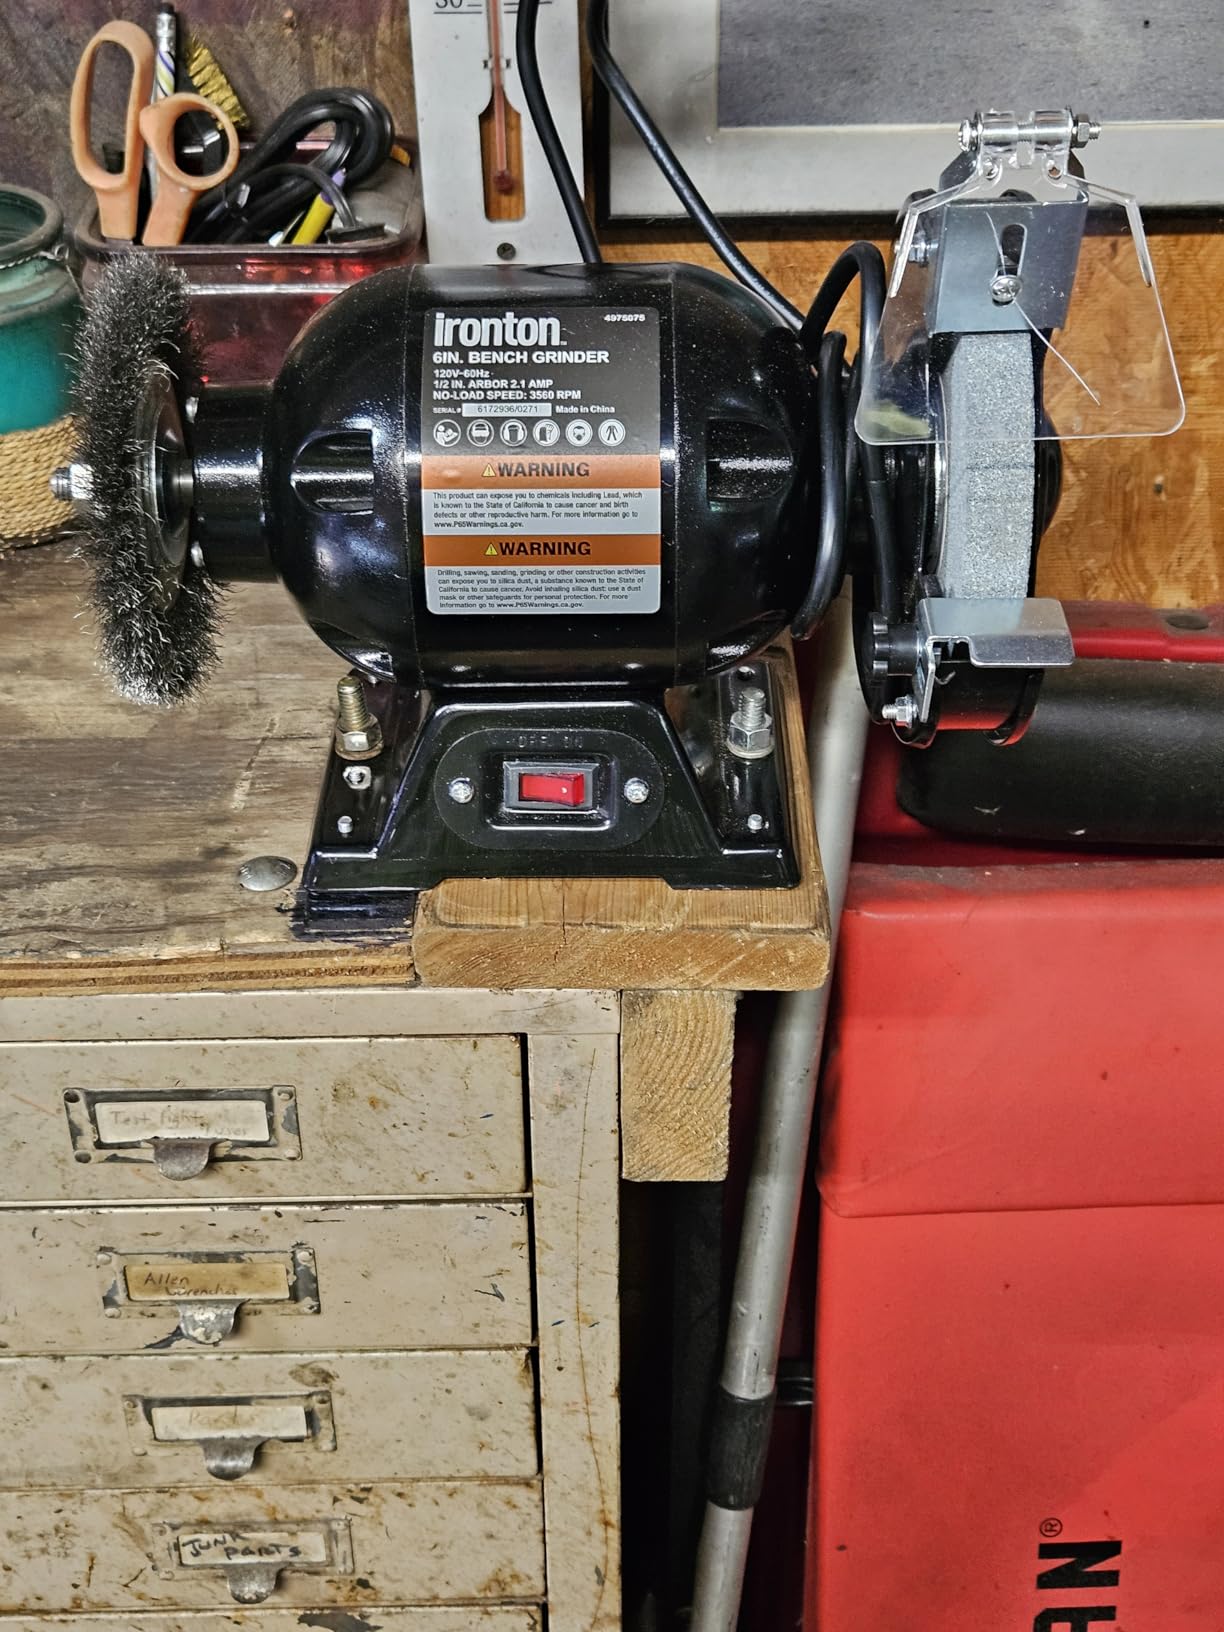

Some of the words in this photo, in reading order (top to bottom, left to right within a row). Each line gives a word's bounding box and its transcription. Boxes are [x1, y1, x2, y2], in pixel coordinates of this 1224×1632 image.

[434, 312, 561, 347] ironton
[433, 351, 464, 364] 6IN.
[468, 351, 528, 364] BENCH
[532, 351, 610, 364] GRINDER
[433, 380, 449, 389] 1/2
[451, 380, 466, 389] IN.
[468, 379, 508, 389] ARBOR
[510, 379, 525, 388] 2.1
[528, 379, 553, 388] AMP
[433, 390, 484, 400] NO-LOAD
[486, 390, 527, 400] SPEED:
[529, 390, 554, 400] 3560
[556, 390, 581, 400] RPM
[477, 405, 538, 413] 6172936/0271
[556, 405, 579, 413] Made
[580, 405, 589, 413] in
[590, 405, 615, 413] China
[498, 462, 590, 477] WARNING
[448, 492, 475, 501] product
[515, 493, 527, 501] you
[571, 491, 602, 500] including
[622, 491, 643, 499] which
[486, 501, 503, 509] State
[504, 501, 512, 509] of
[513, 501, 545, 509] California
[487, 511, 529, 520] reproductive
[621, 511, 630, 519] go
[499, 541, 591, 556] WARNING
[491, 569, 519, 577] sanding,
[520, 569, 547, 577] grinding
[144, 1273, 190, 1286] Allen
